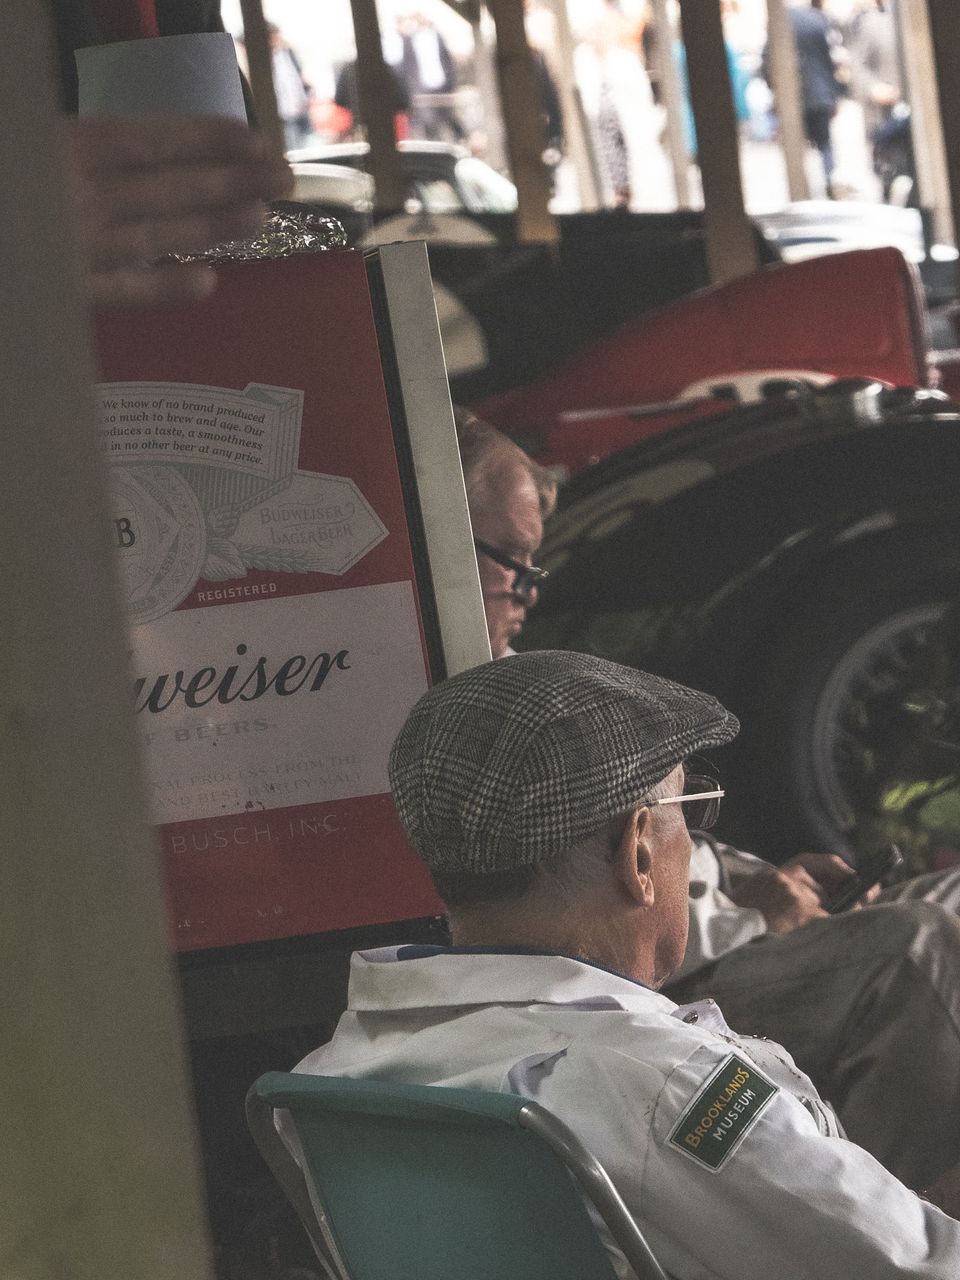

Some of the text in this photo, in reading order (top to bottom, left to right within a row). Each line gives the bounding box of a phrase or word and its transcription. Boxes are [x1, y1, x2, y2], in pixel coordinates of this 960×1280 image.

[103, 399, 265, 424] We know of no brand produced
[104, 411, 265, 437] so much to brew and age. Our
[103, 426, 142, 437] oduces
[155, 427, 185, 438] taste,
[197, 430, 264, 451] smoothness
[111, 439, 264, 465] in no other beer at any price.
[260, 505, 346, 525] BUDWEISER
[269, 526, 320, 546] LAGER
[198, 582, 278, 602] REGISTERED
[130, 642, 352, 714] weiser
[684, 1066, 750, 1148] BROOKLANDS
[712, 1088, 756, 1141] MUSEUM
